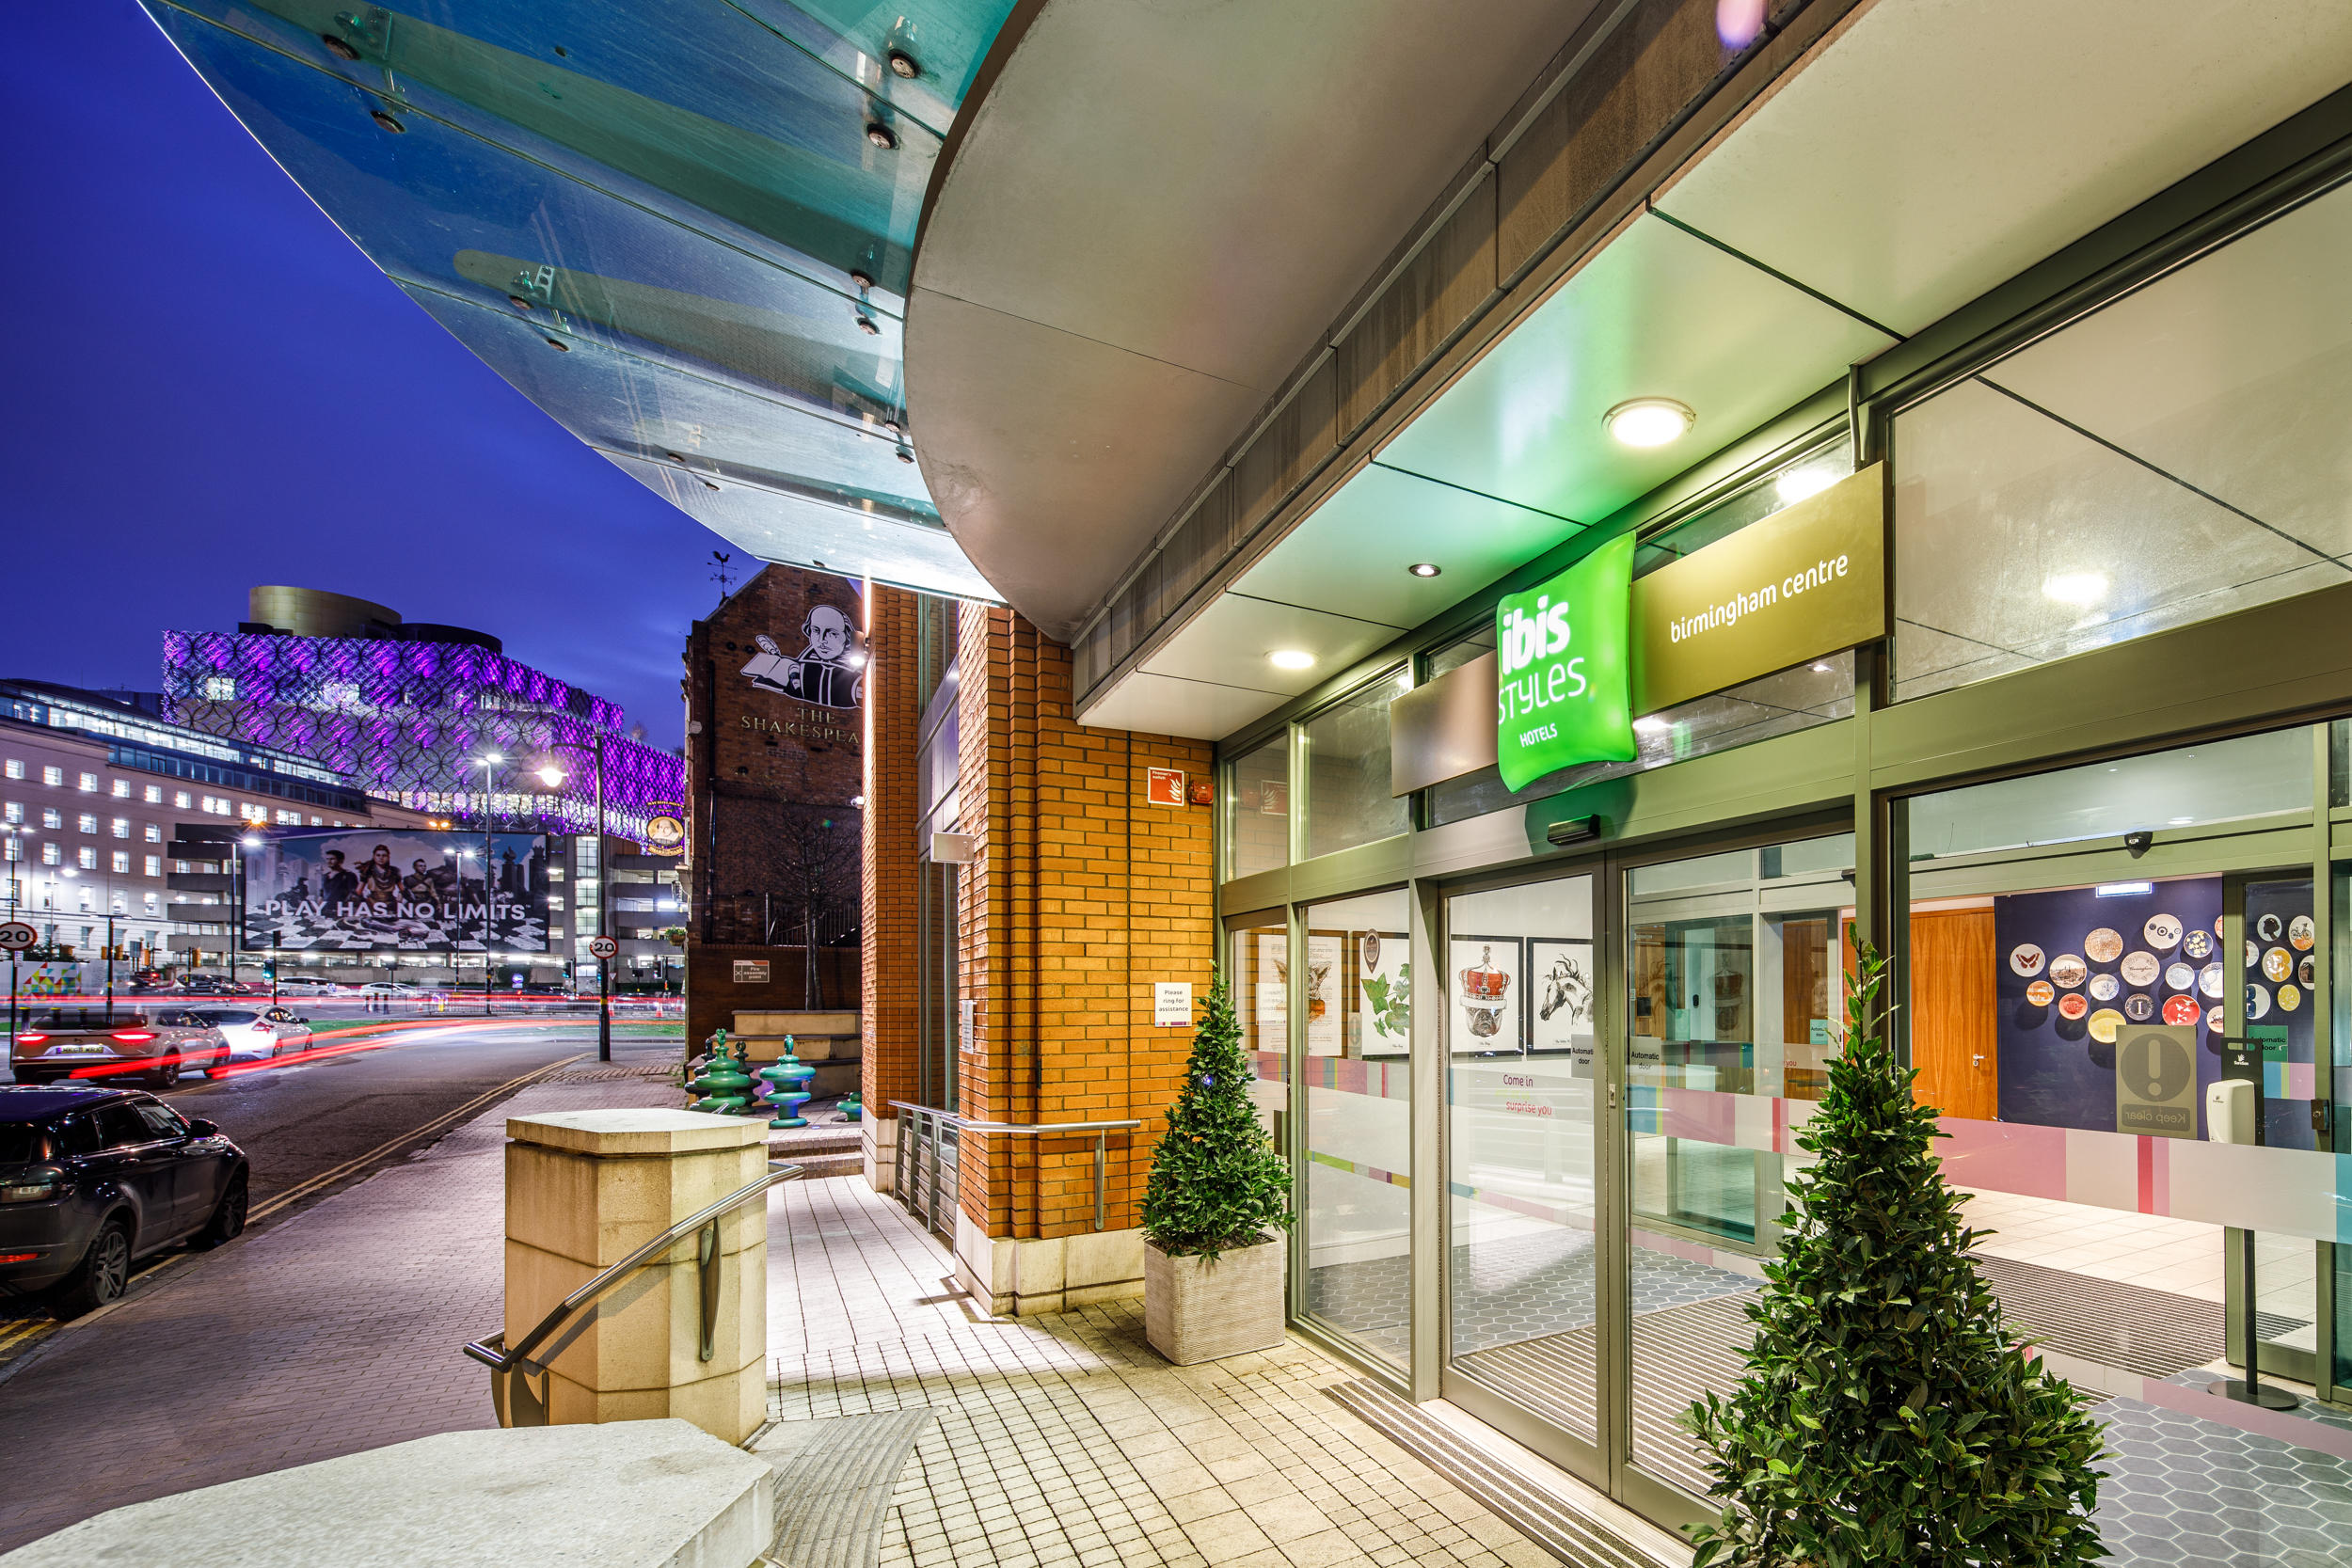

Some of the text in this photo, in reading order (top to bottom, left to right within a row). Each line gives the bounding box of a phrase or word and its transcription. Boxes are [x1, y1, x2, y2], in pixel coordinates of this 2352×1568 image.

[1670, 554, 1849, 643] birmingham centre
[1502, 594, 1571, 675] ibis
[797, 707, 835, 724] THE
[740, 715, 859, 744] SHAKESPEA
[1519, 722, 1558, 748] HOTELS
[264, 899, 327, 917] PLAY
[337, 900, 388, 918] HAS
[396, 901, 436, 919] NO
[0, 930, 30, 942] 20
[594, 942, 615, 953] 20
[1572, 1047, 1595, 1055] Automati
[1630, 1051, 1660, 1060] Automatic
[1638, 1062, 1651, 1070] door
[1502, 1074, 1534, 1087] Come in
[1505, 1101, 1552, 1117] surprise you
